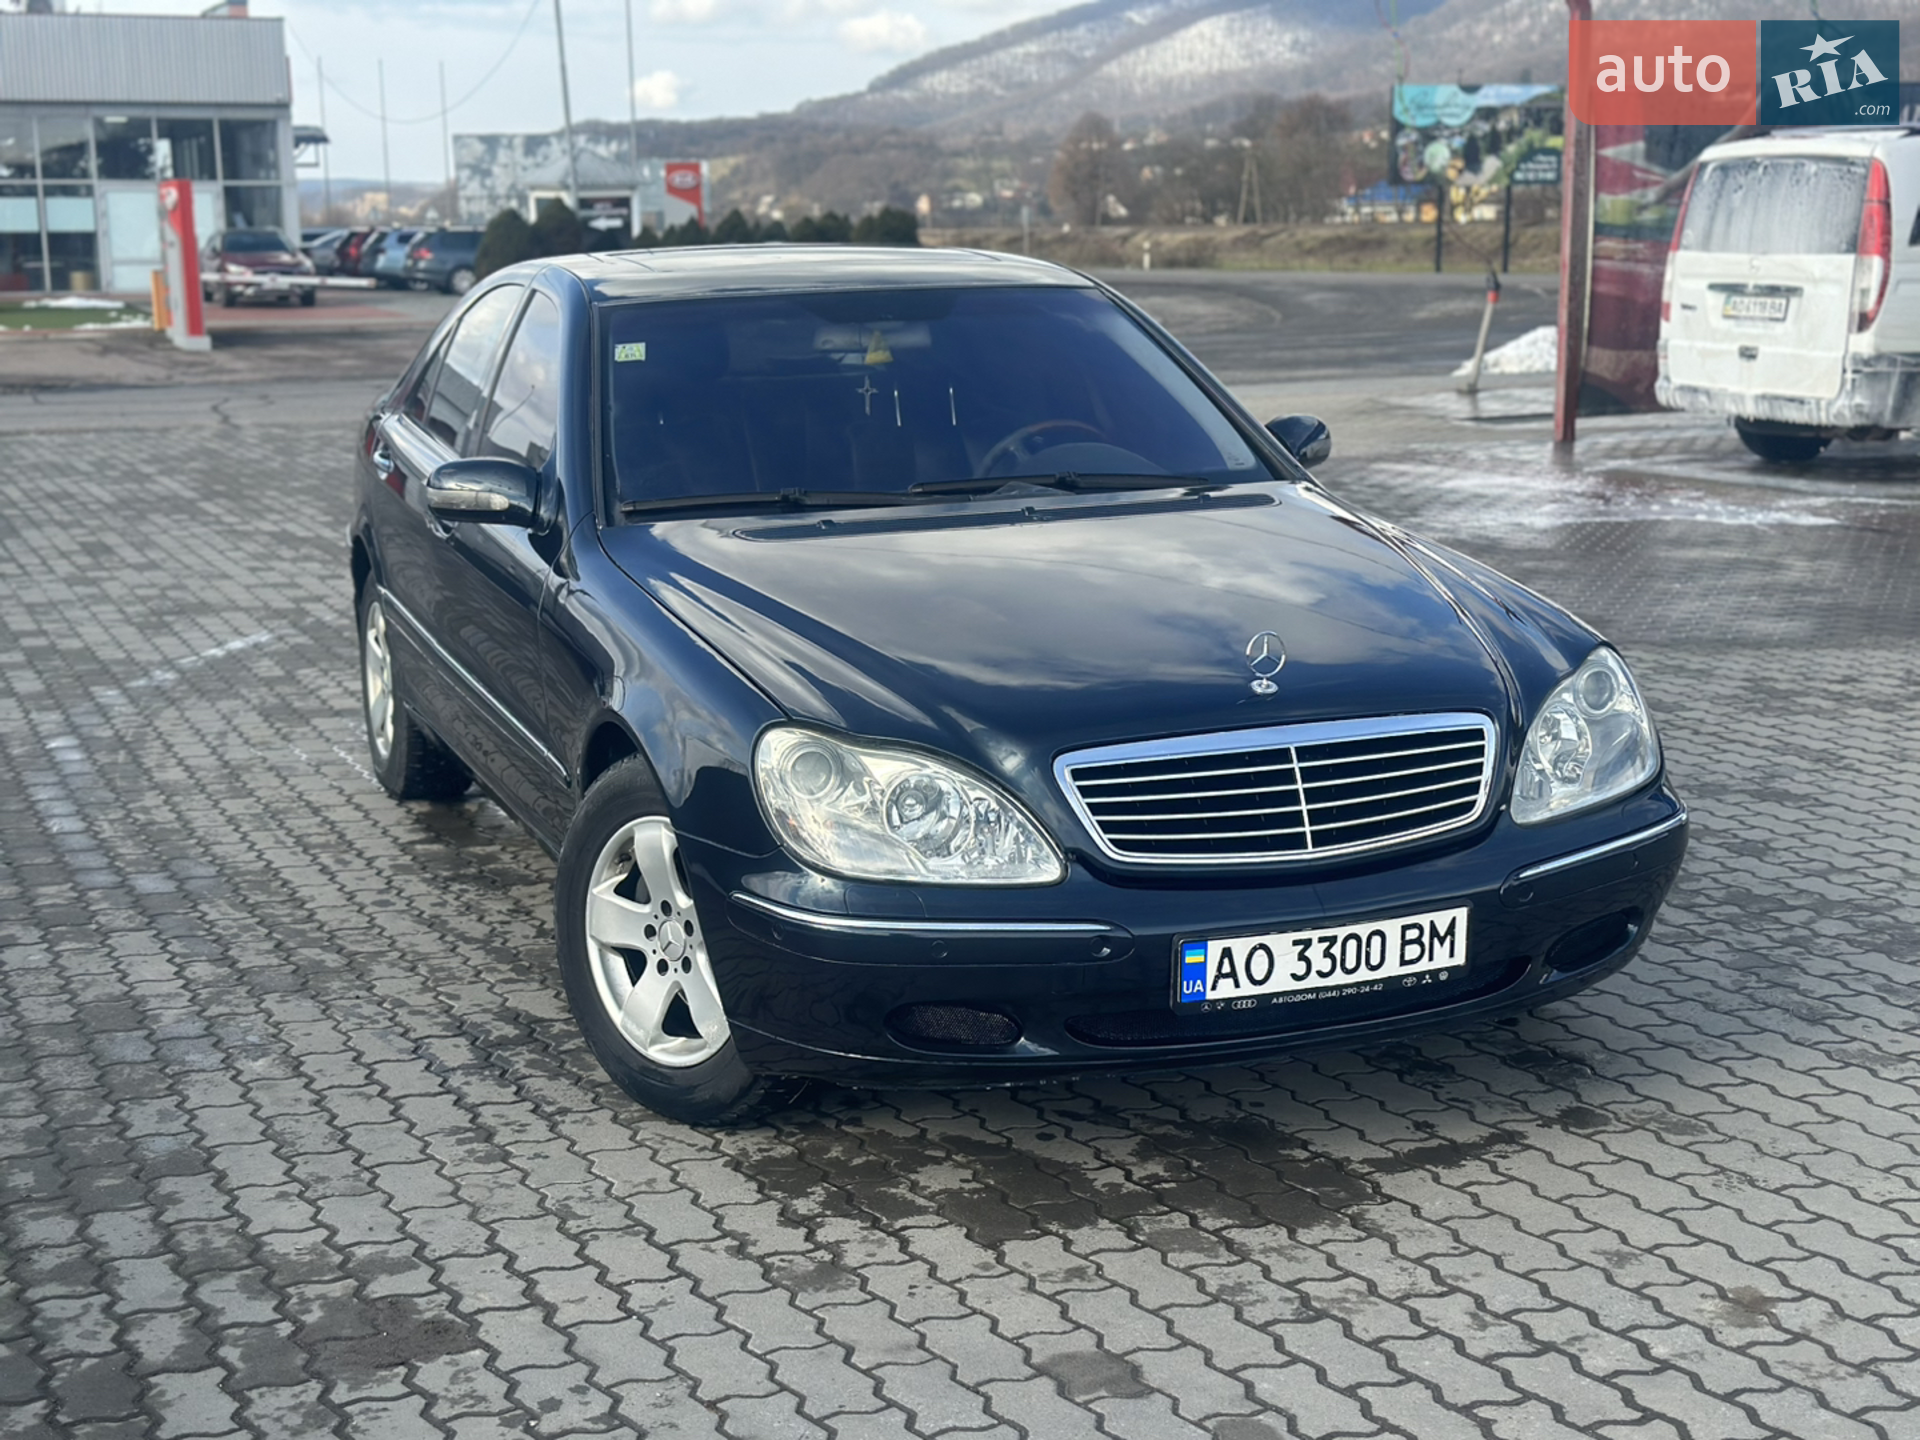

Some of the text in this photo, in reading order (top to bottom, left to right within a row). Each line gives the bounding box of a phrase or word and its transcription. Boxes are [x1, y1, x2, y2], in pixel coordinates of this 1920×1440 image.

[1210, 916, 1457, 991] AO 3300 BM
[1183, 979, 1204, 994] UA
[1271, 992, 1317, 1005] АВТОДОМ
[1341, 983, 1384, 997] 290-24-42
